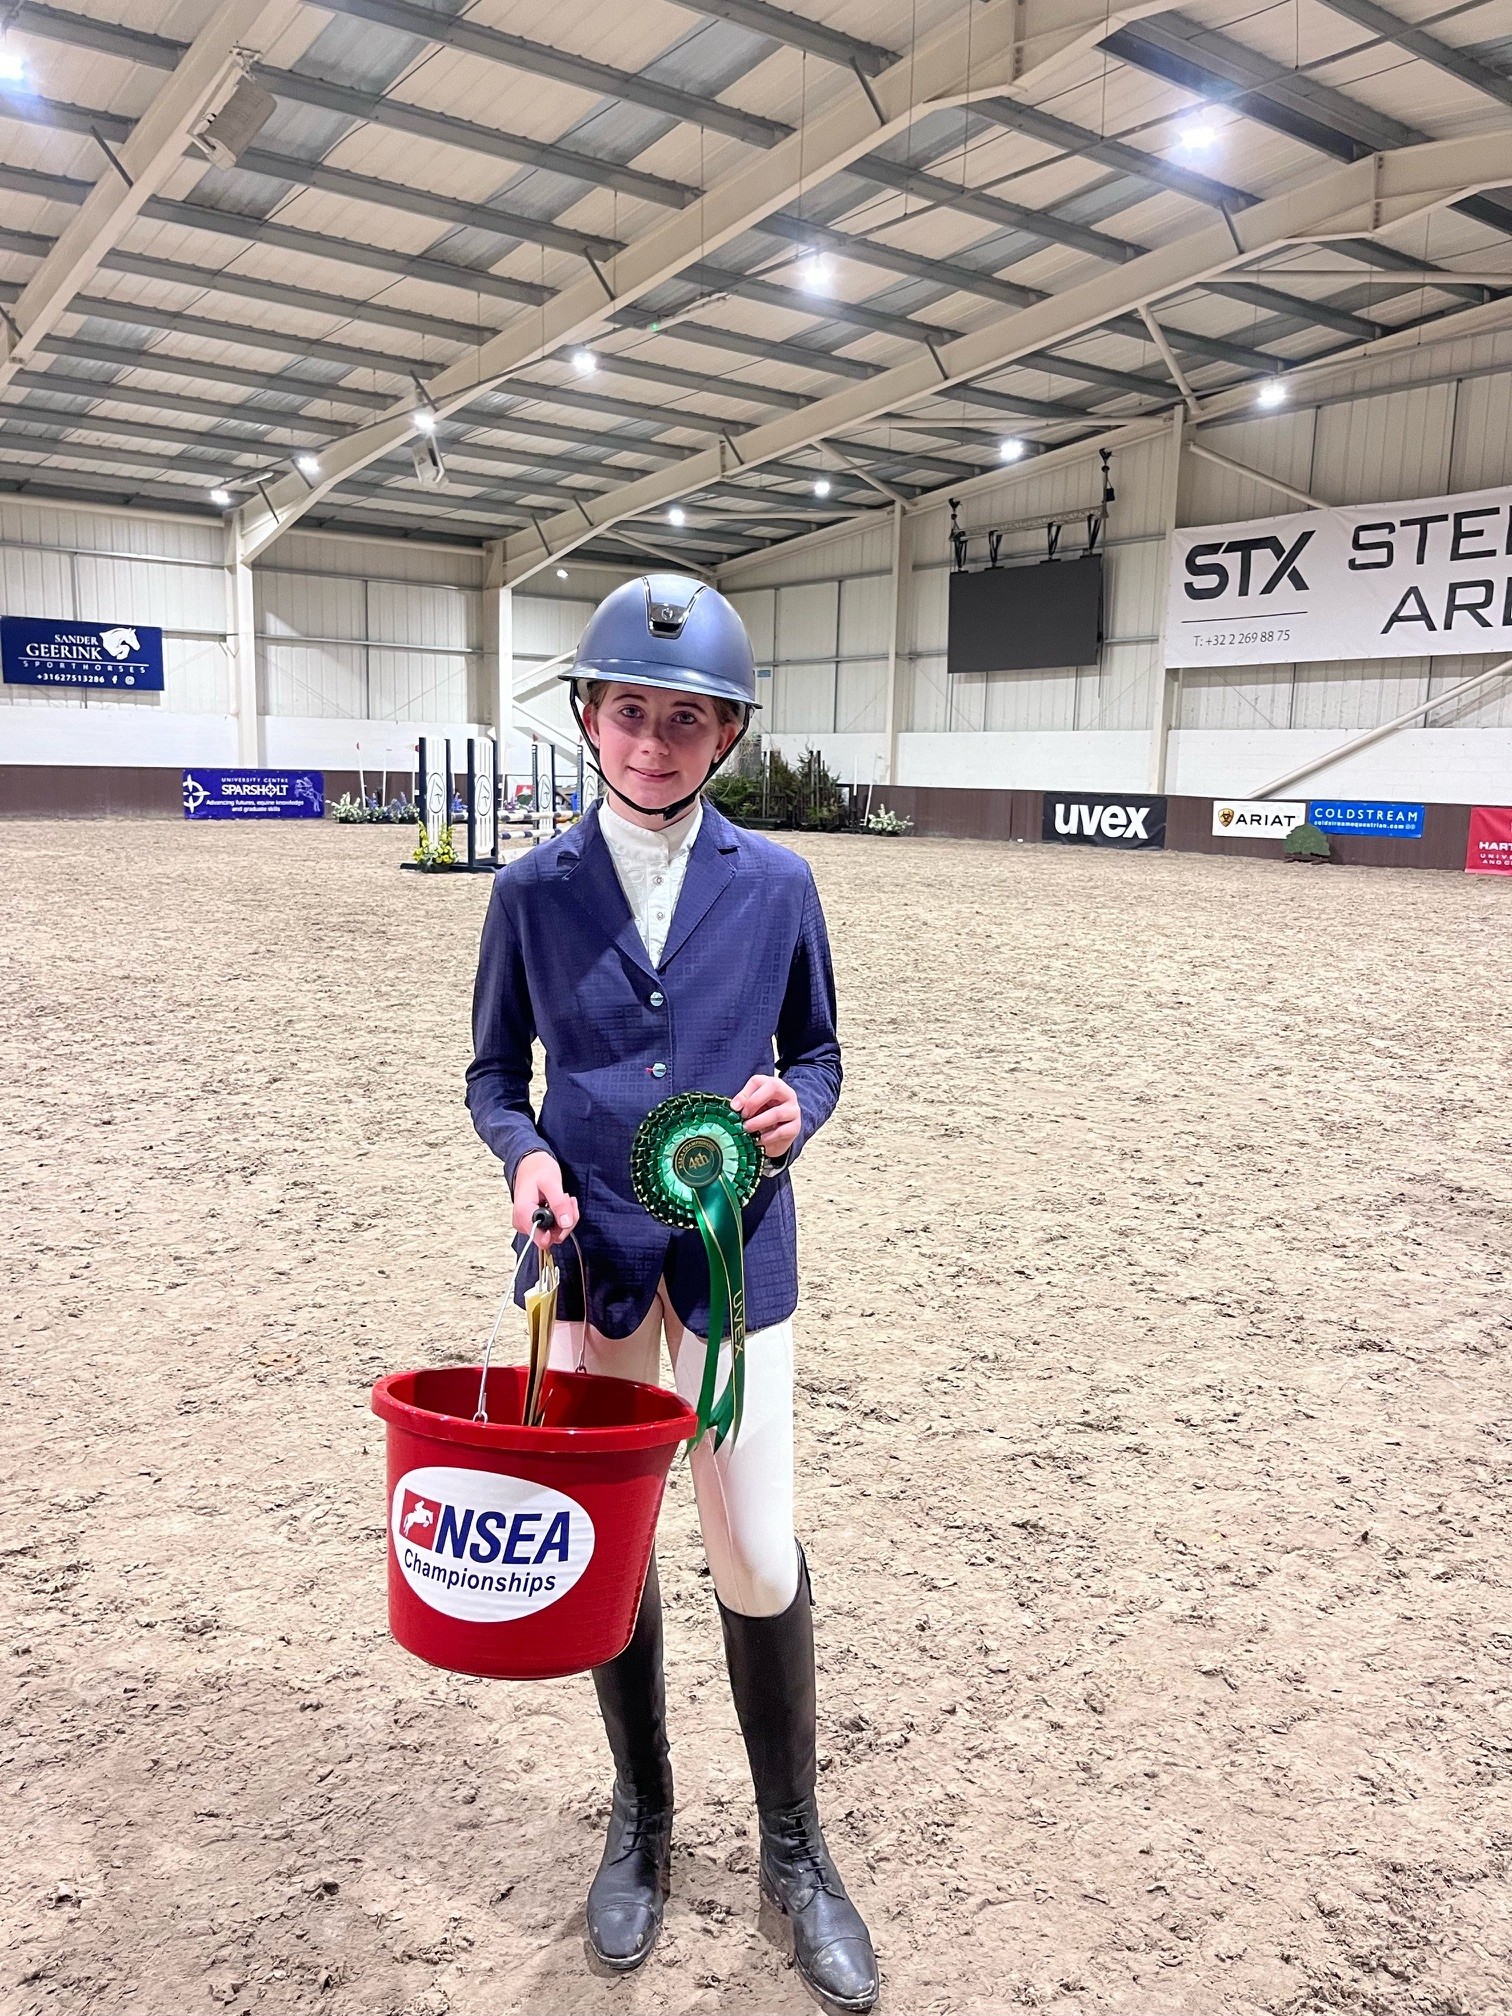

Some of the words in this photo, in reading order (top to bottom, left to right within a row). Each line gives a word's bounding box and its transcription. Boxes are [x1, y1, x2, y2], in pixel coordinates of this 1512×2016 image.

[1348, 505, 1512, 571] STE
[1183, 529, 1316, 601] STX
[1380, 576, 1512, 635] AR
[54, 634, 99, 645] SANDER
[1193, 635, 1203, 647] T:
[1205, 634, 1226, 646] +32
[1228, 633, 1236, 645] 2
[1237, 632, 1258, 644] 269
[1260, 630, 1274, 642] 88
[1277, 629, 1291, 641] 75
[25, 643, 102, 660] GEERINK
[23, 661, 146, 673] SPORTHORSES
[221, 783, 289, 797] SPARSHOLT
[1054, 803, 1151, 839] uvex
[1235, 813, 1296, 828] ARIAT
[1314, 807, 1418, 822] COLDSTREAM
[689, 1152, 710, 1170] 4th
[732, 1289, 744, 1359] UVEX
[435, 1504, 571, 1565] NSEA
[404, 1548, 556, 1597] Championships
